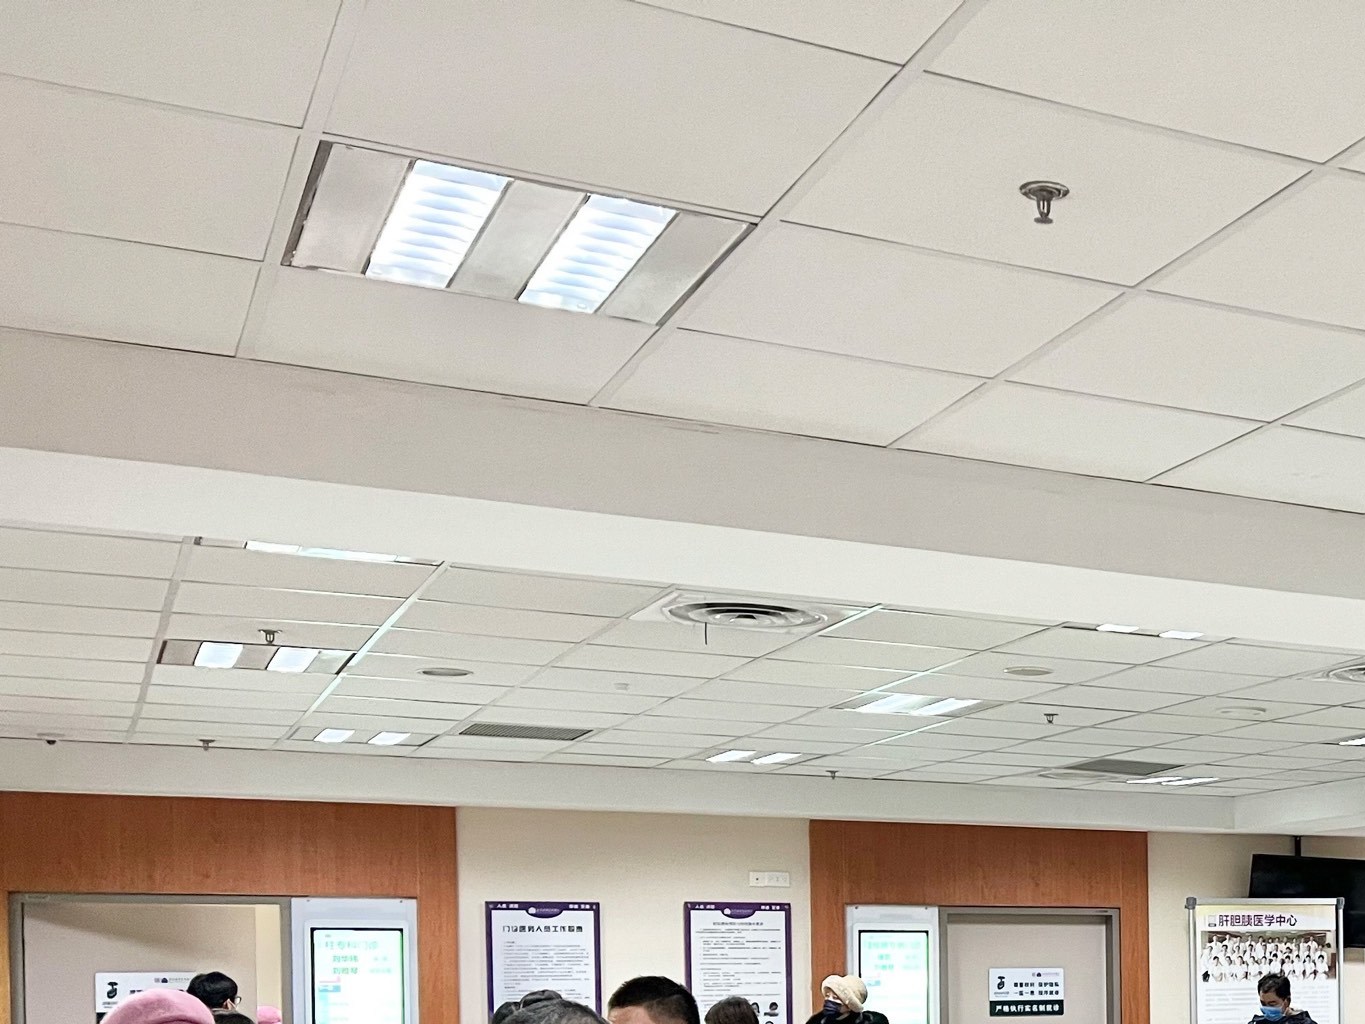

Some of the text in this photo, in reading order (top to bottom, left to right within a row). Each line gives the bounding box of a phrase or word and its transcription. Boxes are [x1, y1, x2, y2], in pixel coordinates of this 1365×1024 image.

[1218, 914, 1298, 927] 肝胆胰医学中心
